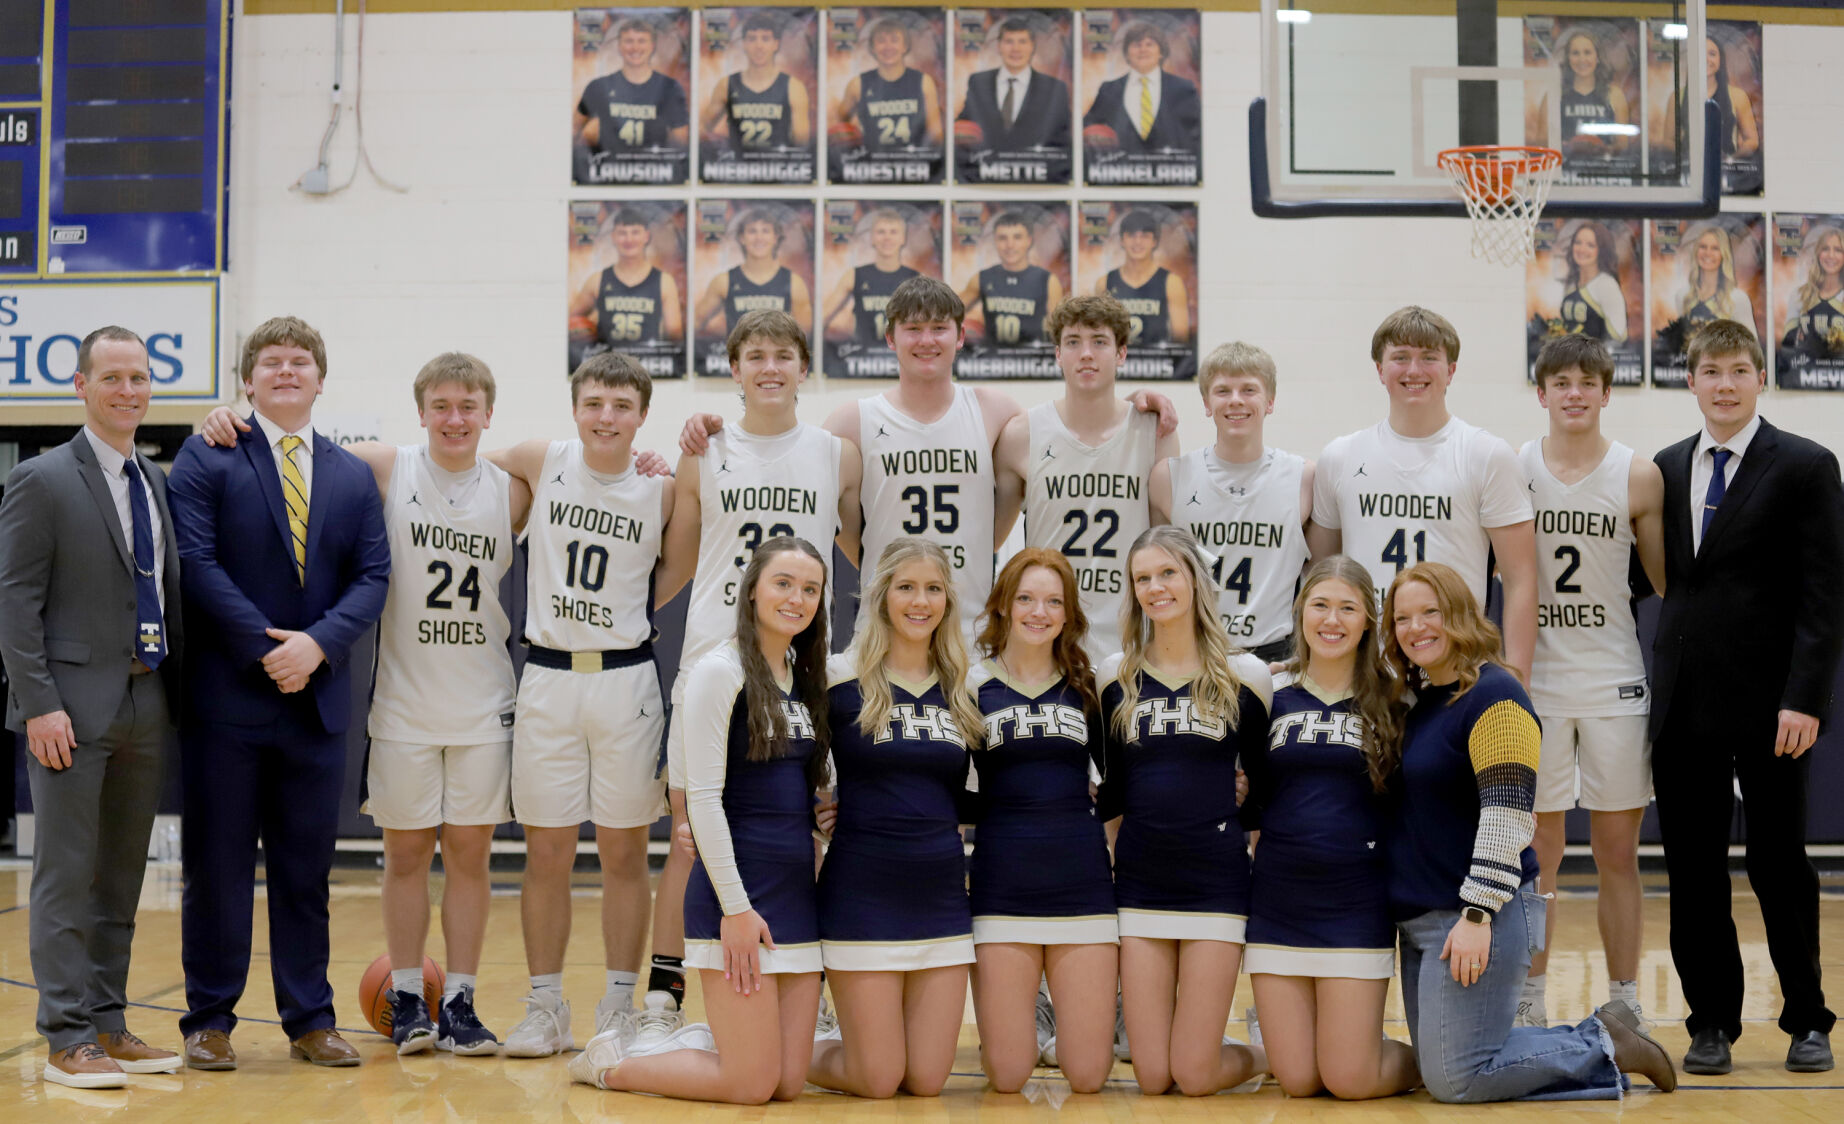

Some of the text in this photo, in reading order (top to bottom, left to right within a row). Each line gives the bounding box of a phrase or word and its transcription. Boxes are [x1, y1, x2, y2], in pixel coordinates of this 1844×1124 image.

[618, 120, 644, 146] 41
[740, 121, 773, 146] 22
[877, 118, 910, 145] 24
[588, 162, 674, 182] LAWSON
[703, 161, 812, 180] NIEBRUGGE
[843, 160, 931, 181] KOESTER
[979, 161, 1048, 180] METTE
[611, 314, 644, 341] 35
[995, 315, 1021, 343] 10
[0, 333, 184, 385] HOS
[1800, 368, 1844, 388] MEY
[882, 448, 978, 476] WOODEN
[720, 486, 817, 515] WOODEN
[1045, 473, 1140, 500] WOODEN
[901, 484, 960, 535] 35
[1359, 493, 1452, 520] WOODEN
[550, 500, 643, 545] WOODEN
[1060, 509, 1120, 558] 22
[1191, 521, 1284, 548] WOODEN
[1535, 510, 1616, 538] OODEN
[411, 522, 496, 562] WOODEN
[1381, 528, 1427, 573] 41
[565, 539, 609, 593] 10
[1553, 545, 1583, 593] 2
[425, 559, 481, 612] 24
[1211, 555, 1253, 606] 14
[552, 594, 614, 629] SHOES
[1538, 604, 1606, 628] SHOES
[418, 619, 487, 645] SHOES
[874, 703, 967, 751] THS
[983, 703, 1089, 751] THS
[1126, 696, 1227, 744] THS
[1269, 710, 1364, 751] THS
